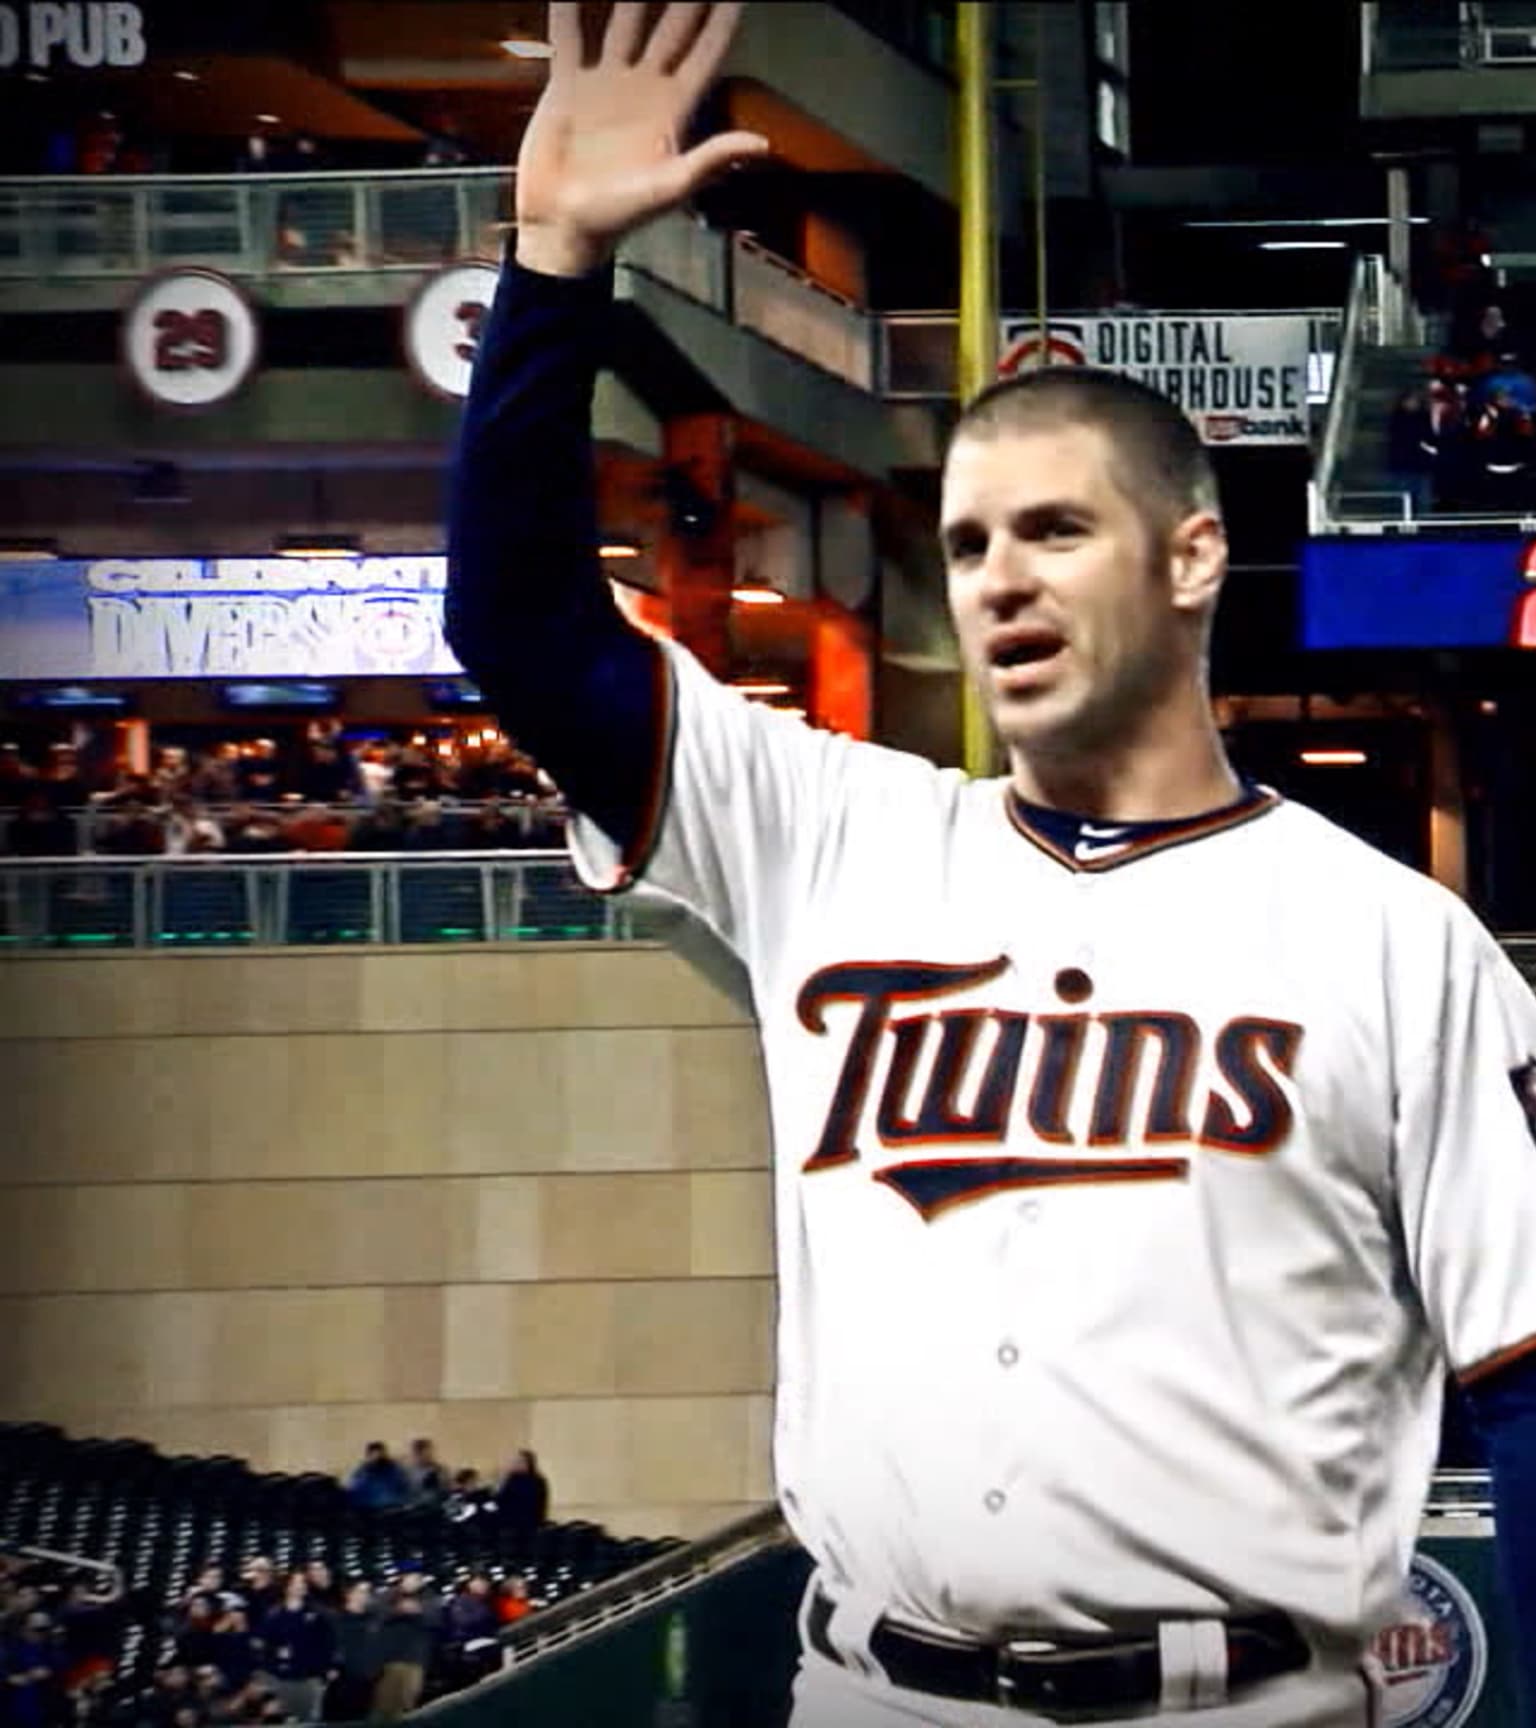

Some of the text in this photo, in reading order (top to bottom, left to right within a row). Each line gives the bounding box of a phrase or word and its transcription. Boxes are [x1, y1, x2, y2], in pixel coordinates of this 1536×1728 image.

[29, 1, 148, 68] PUB
[1097, 321, 1231, 364] DIGITAL
[1124, 366, 1300, 409] BHOUSE
[796, 954, 1304, 1173] Twins
